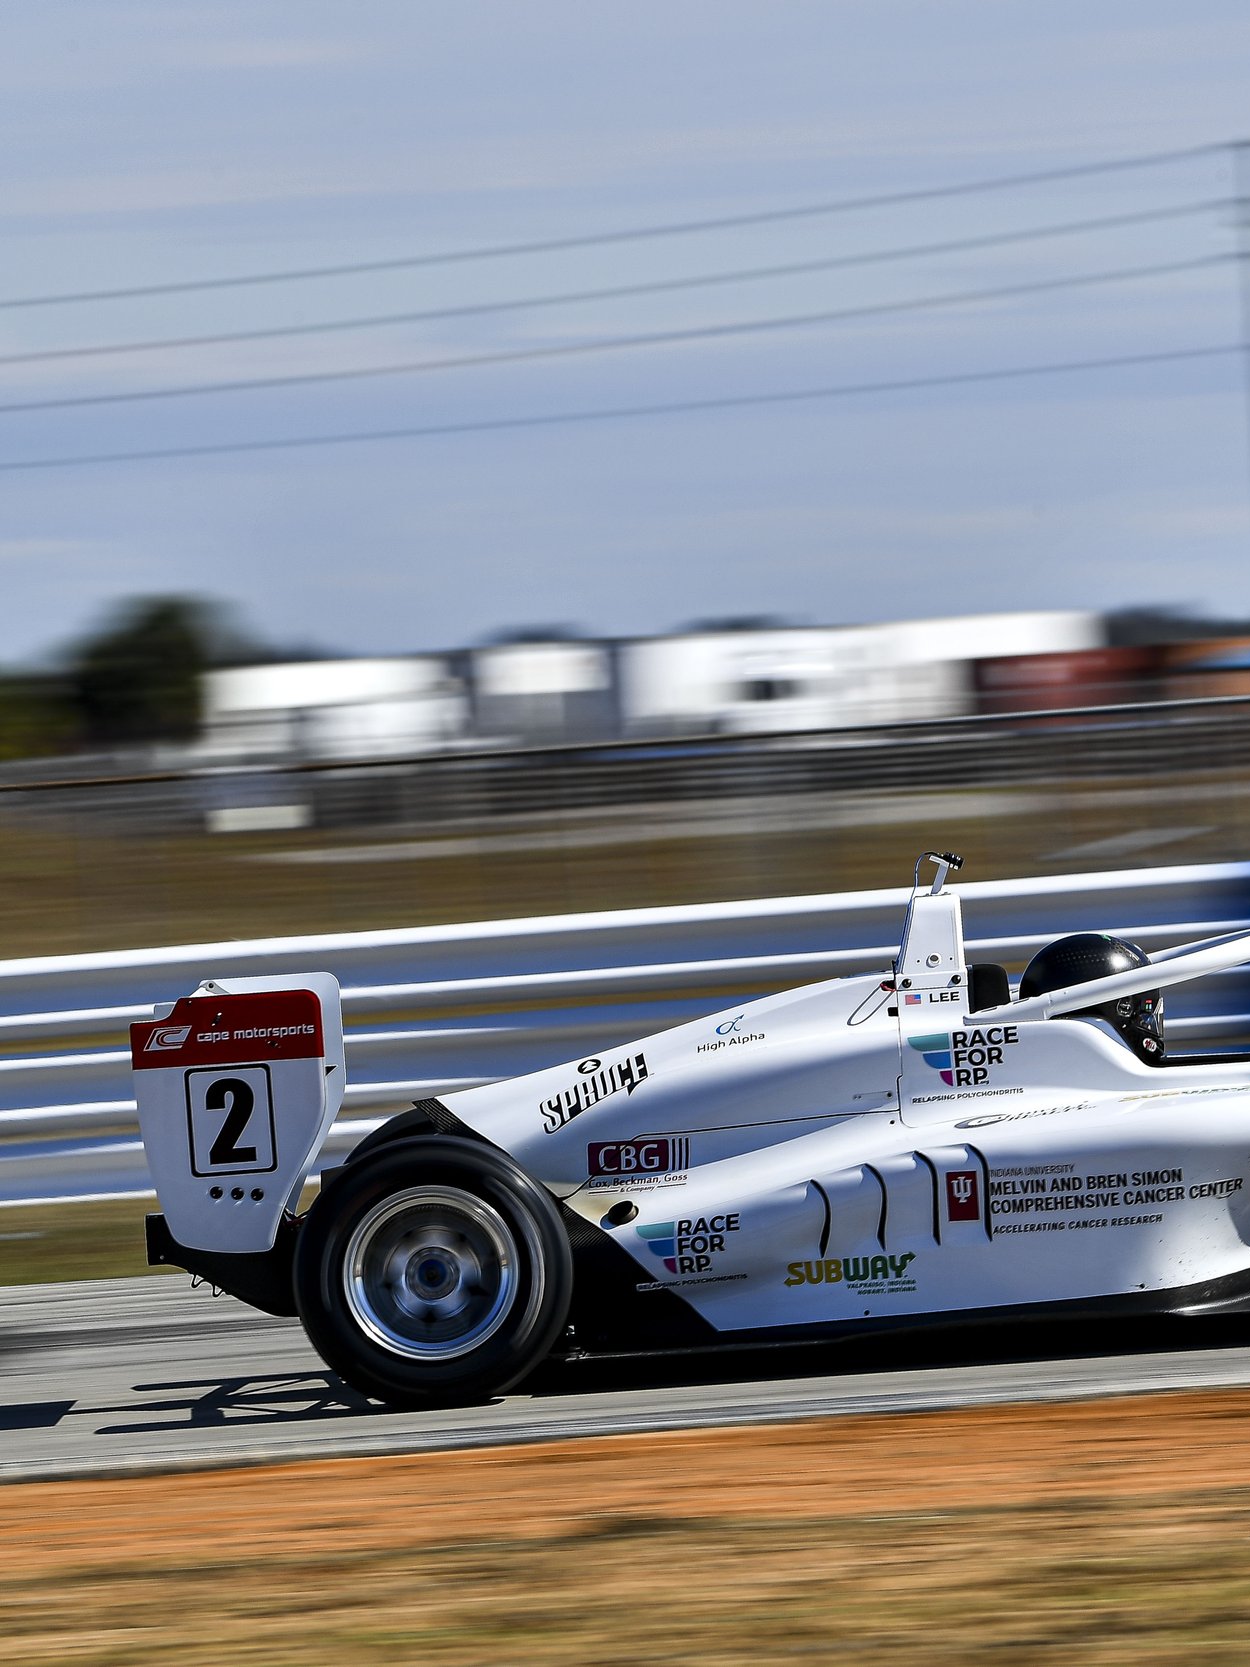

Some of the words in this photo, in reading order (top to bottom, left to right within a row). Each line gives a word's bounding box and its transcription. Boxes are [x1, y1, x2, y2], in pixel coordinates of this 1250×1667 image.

[929, 991, 960, 1004] LEE
[197, 1031, 229, 1044] cape
[233, 1023, 315, 1041] motorsports
[697, 1040, 726, 1053] High
[729, 1033, 765, 1046] Alpha
[952, 1026, 1019, 1049] RACE
[954, 1047, 1004, 1068] FOR
[539, 1053, 649, 1134] SPRUCE
[912, 1093, 956, 1104] RELAPSING
[957, 1087, 1024, 1100] POLYCHONDRITIS
[205, 1078, 258, 1165] 2
[598, 1143, 660, 1172] CBG
[588, 1179, 611, 1189] Cox,
[613, 1175, 661, 1187] Beckman,
[664, 1173, 688, 1182] Goss
[1024, 1164, 1076, 1176] UNIVERSITY
[990, 1179, 1046, 1196] MELVIN
[1050, 1177, 1083, 1193] AND
[1086, 1173, 1128, 1190] BREN
[1132, 1168, 1183, 1186] SIMON
[990, 1192, 1120, 1214] COMPREHENSIVE
[1123, 1186, 1185, 1206] CANCER
[1189, 1177, 1244, 1199] CENTER
[677, 1213, 740, 1237] RACE
[993, 1221, 1066, 1235] ACCELERATING
[1068, 1218, 1108, 1230] CANCER
[1110, 1213, 1163, 1227] RESEARCH
[677, 1233, 725, 1255] FOR
[783, 1251, 917, 1287] SUBWAY
